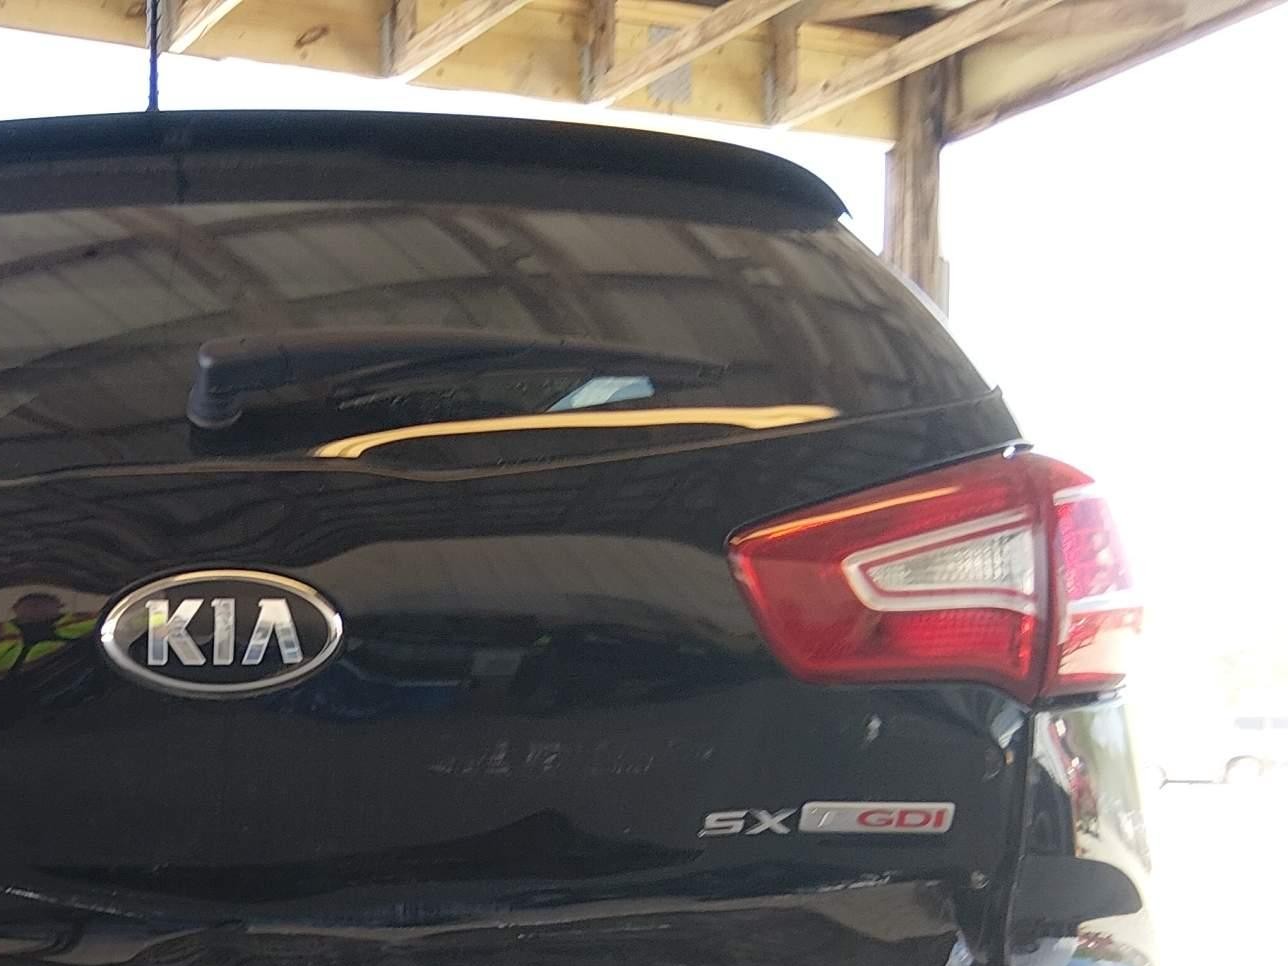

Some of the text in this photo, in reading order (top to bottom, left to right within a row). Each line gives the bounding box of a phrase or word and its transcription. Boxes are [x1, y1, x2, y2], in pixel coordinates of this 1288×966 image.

[145, 598, 304, 666] KIA
[697, 807, 799, 839] SX
[857, 809, 948, 829] GDI
